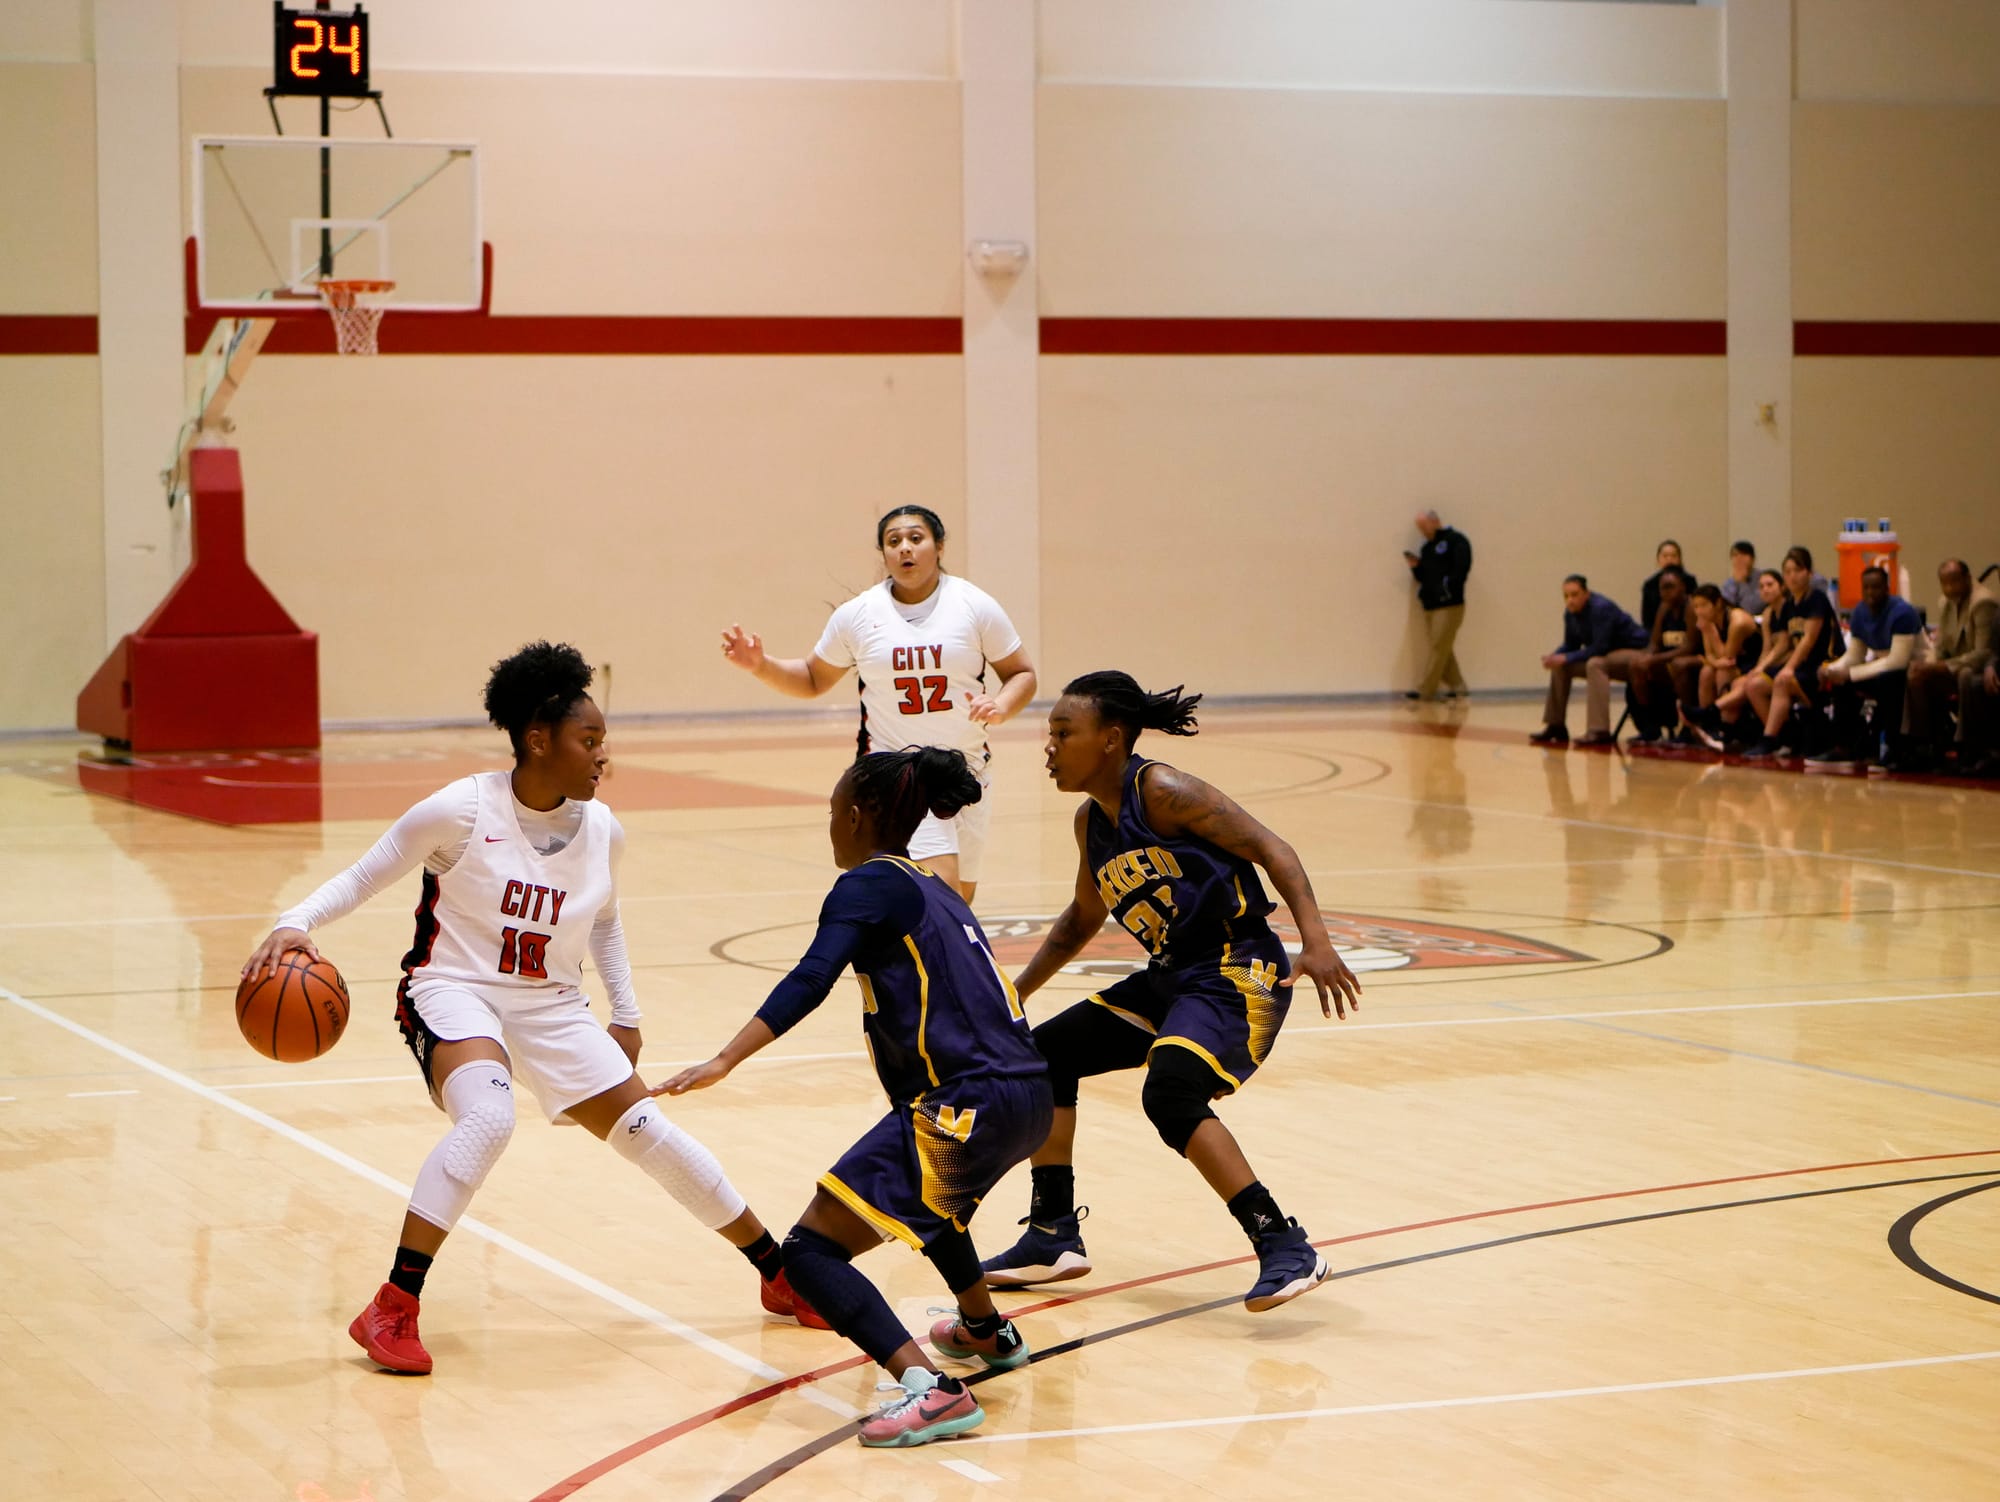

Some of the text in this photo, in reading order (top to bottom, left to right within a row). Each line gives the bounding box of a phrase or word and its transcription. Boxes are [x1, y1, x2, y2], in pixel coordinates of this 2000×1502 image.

[290, 19, 361, 78] 24
[892, 643, 943, 671] CITY
[893, 675, 953, 715] 32
[500, 879, 567, 926] CITY
[498, 926, 552, 980] 10
